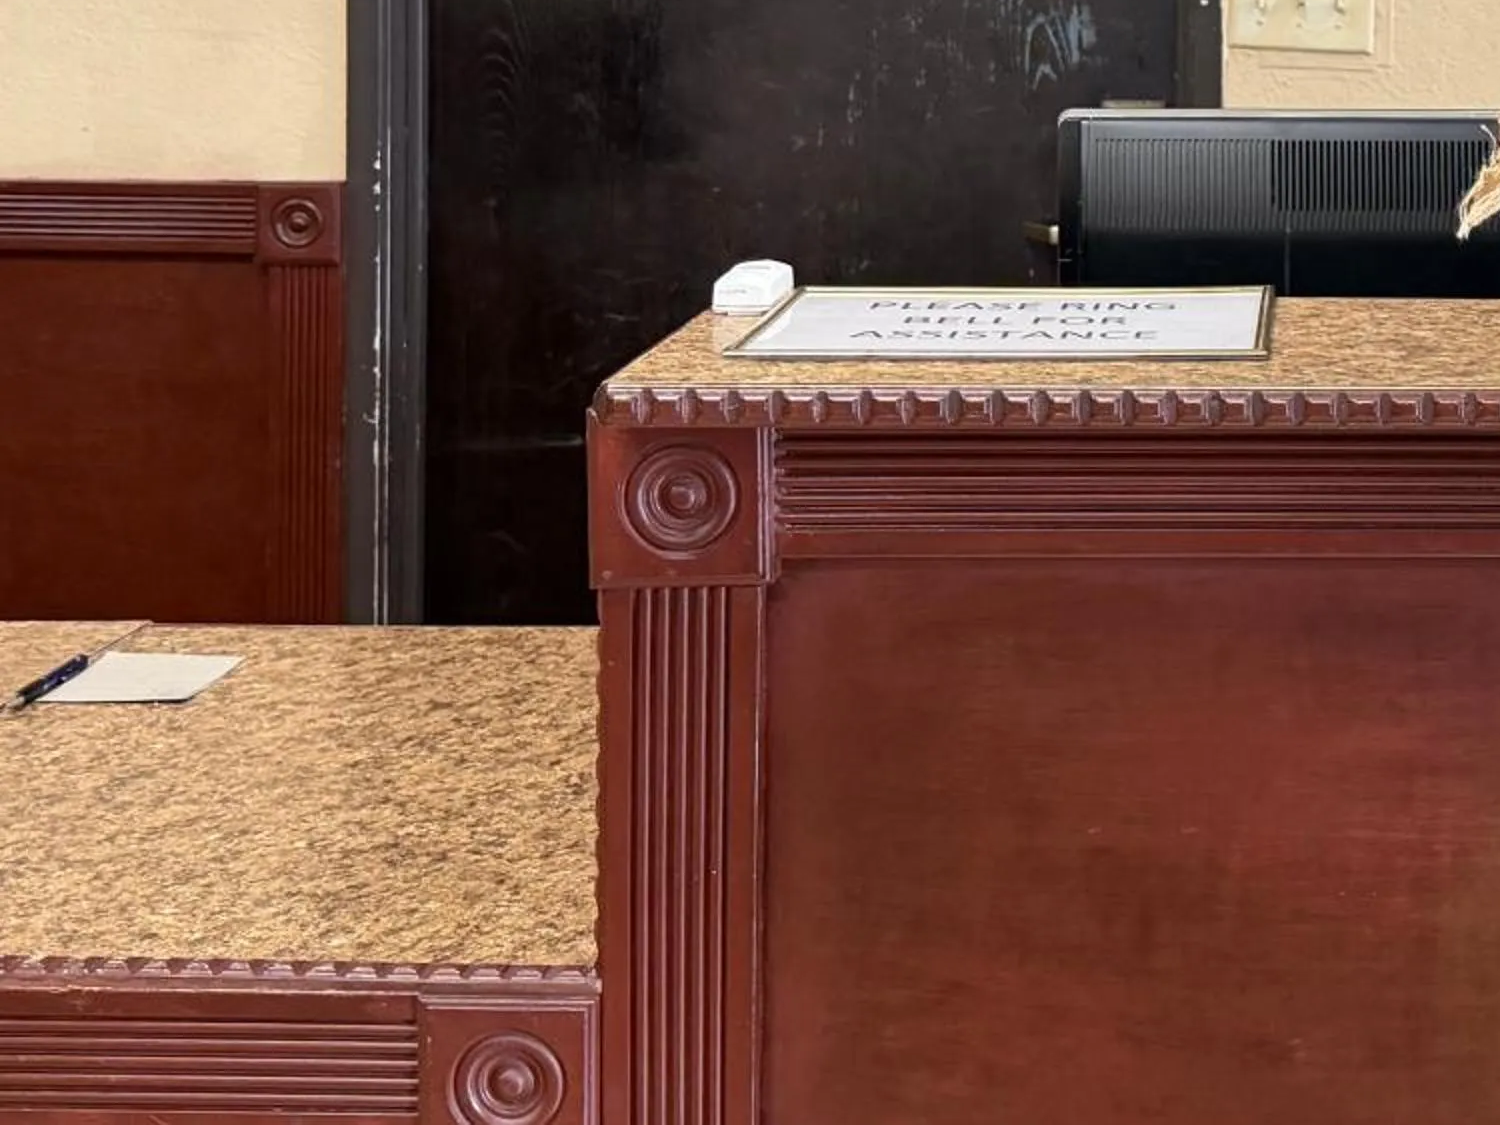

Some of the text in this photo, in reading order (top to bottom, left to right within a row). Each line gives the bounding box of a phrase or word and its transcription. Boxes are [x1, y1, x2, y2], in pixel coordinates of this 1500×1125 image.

[869, 301, 1177, 311] PLEASE RING
[903, 315, 1127, 325] BELL FOR
[849, 329, 1160, 340] ASSISTANCE
